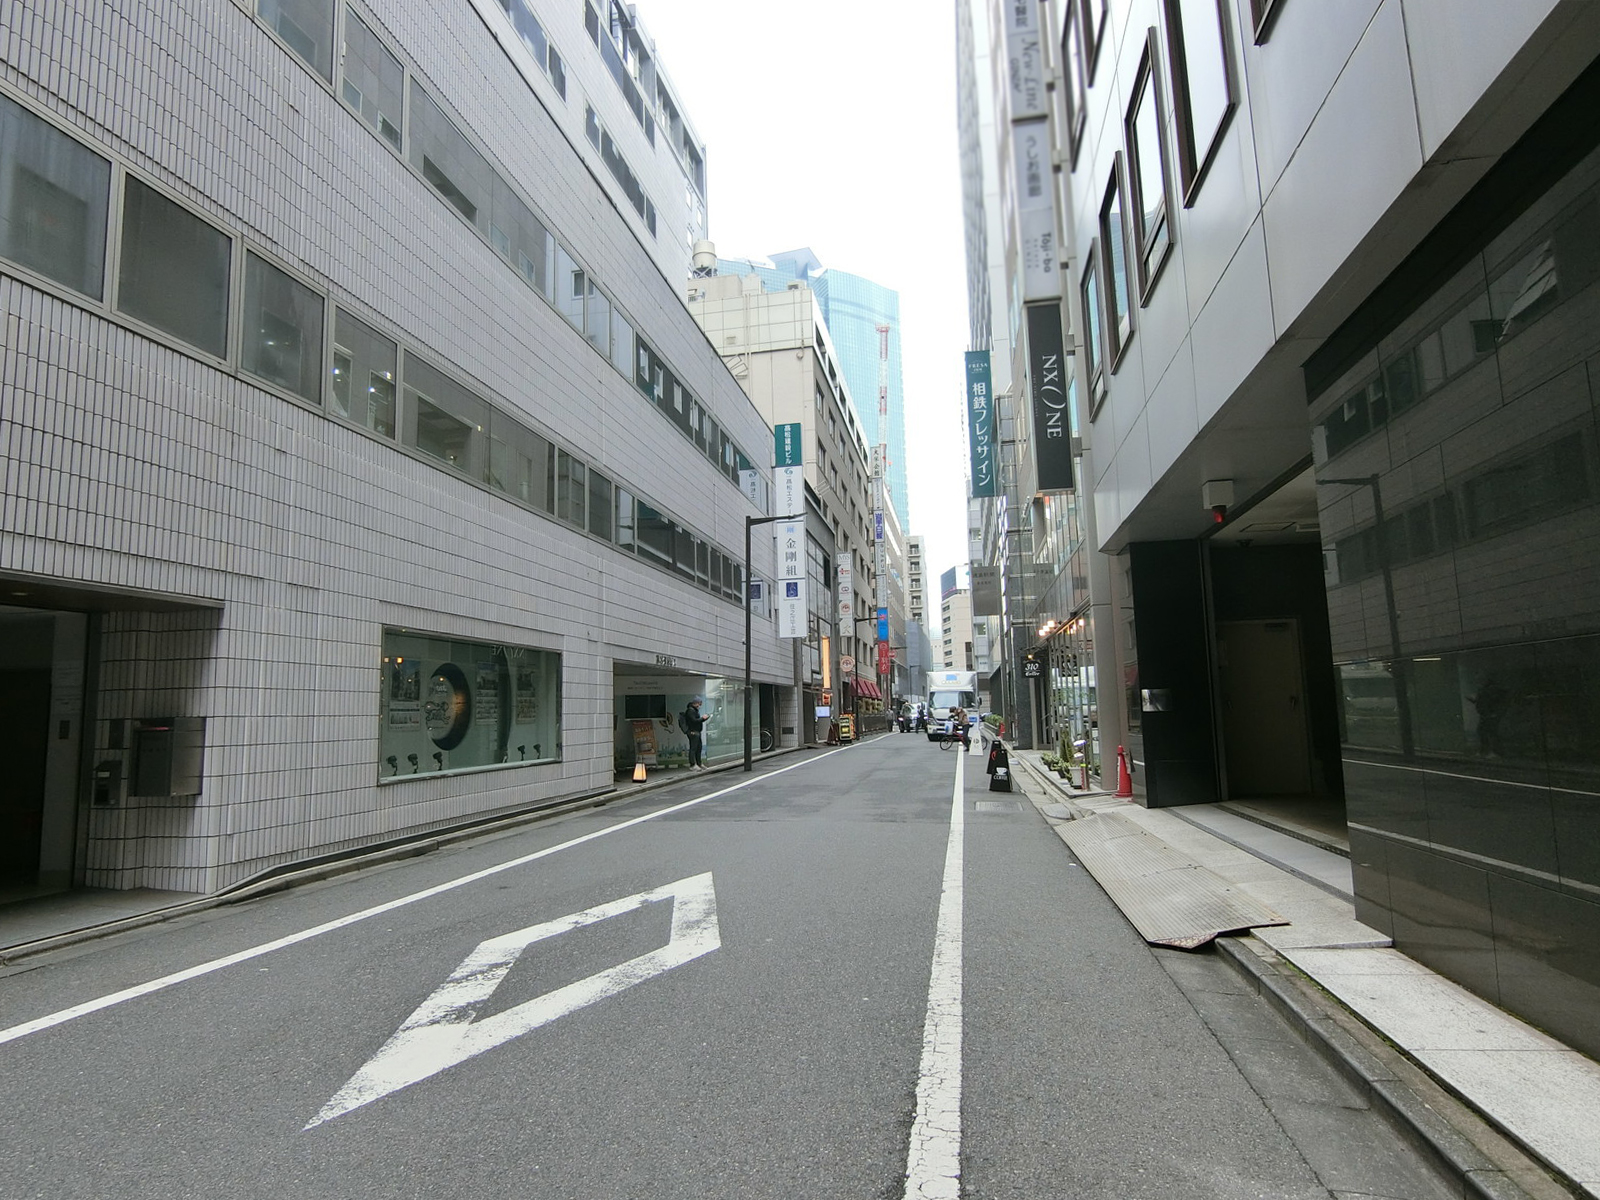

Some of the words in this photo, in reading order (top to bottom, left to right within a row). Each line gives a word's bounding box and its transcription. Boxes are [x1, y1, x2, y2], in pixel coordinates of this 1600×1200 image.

[972, 382, 991, 487] 相鉄フレッサイン
[784, 537, 798, 576] 金剛組
[1024, 663, 1039, 671] 310
